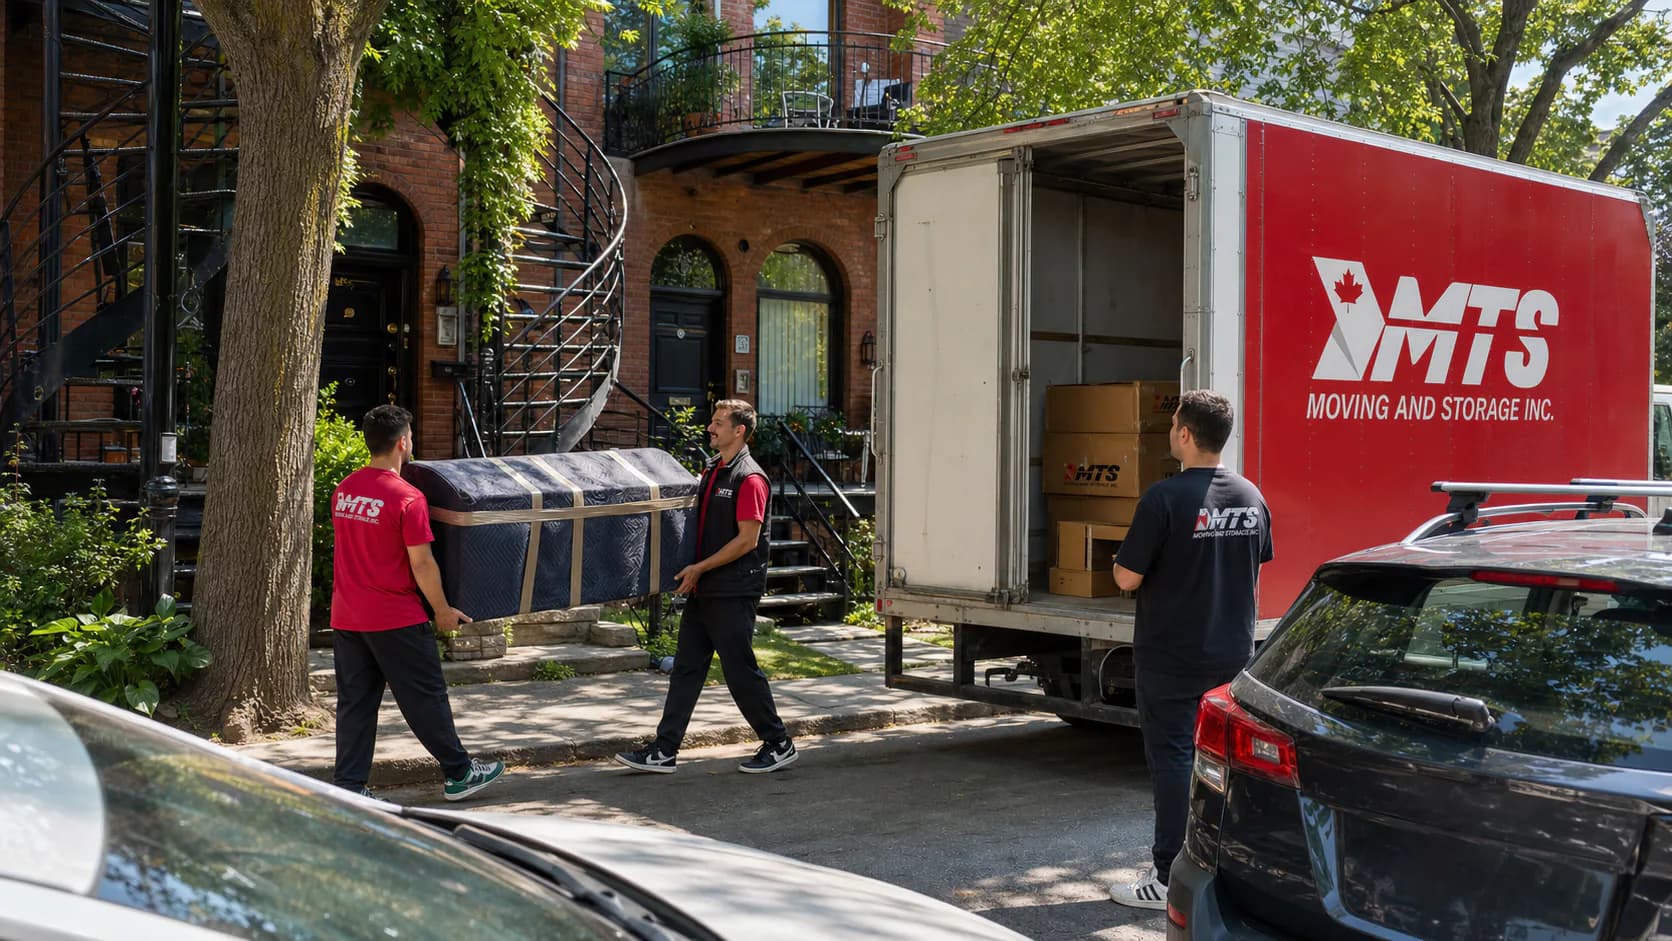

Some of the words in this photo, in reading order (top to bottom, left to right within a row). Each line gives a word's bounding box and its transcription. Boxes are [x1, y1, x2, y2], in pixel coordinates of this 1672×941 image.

[1370, 276, 1559, 389] MTS
[1306, 393, 1389, 420] MOVING
[1394, 395, 1436, 420] AND
[1440, 396, 1520, 421] STORAGE
[1524, 398, 1554, 421] INC.
[1074, 464, 1120, 481] MTS
[1209, 507, 1259, 529] MTS
